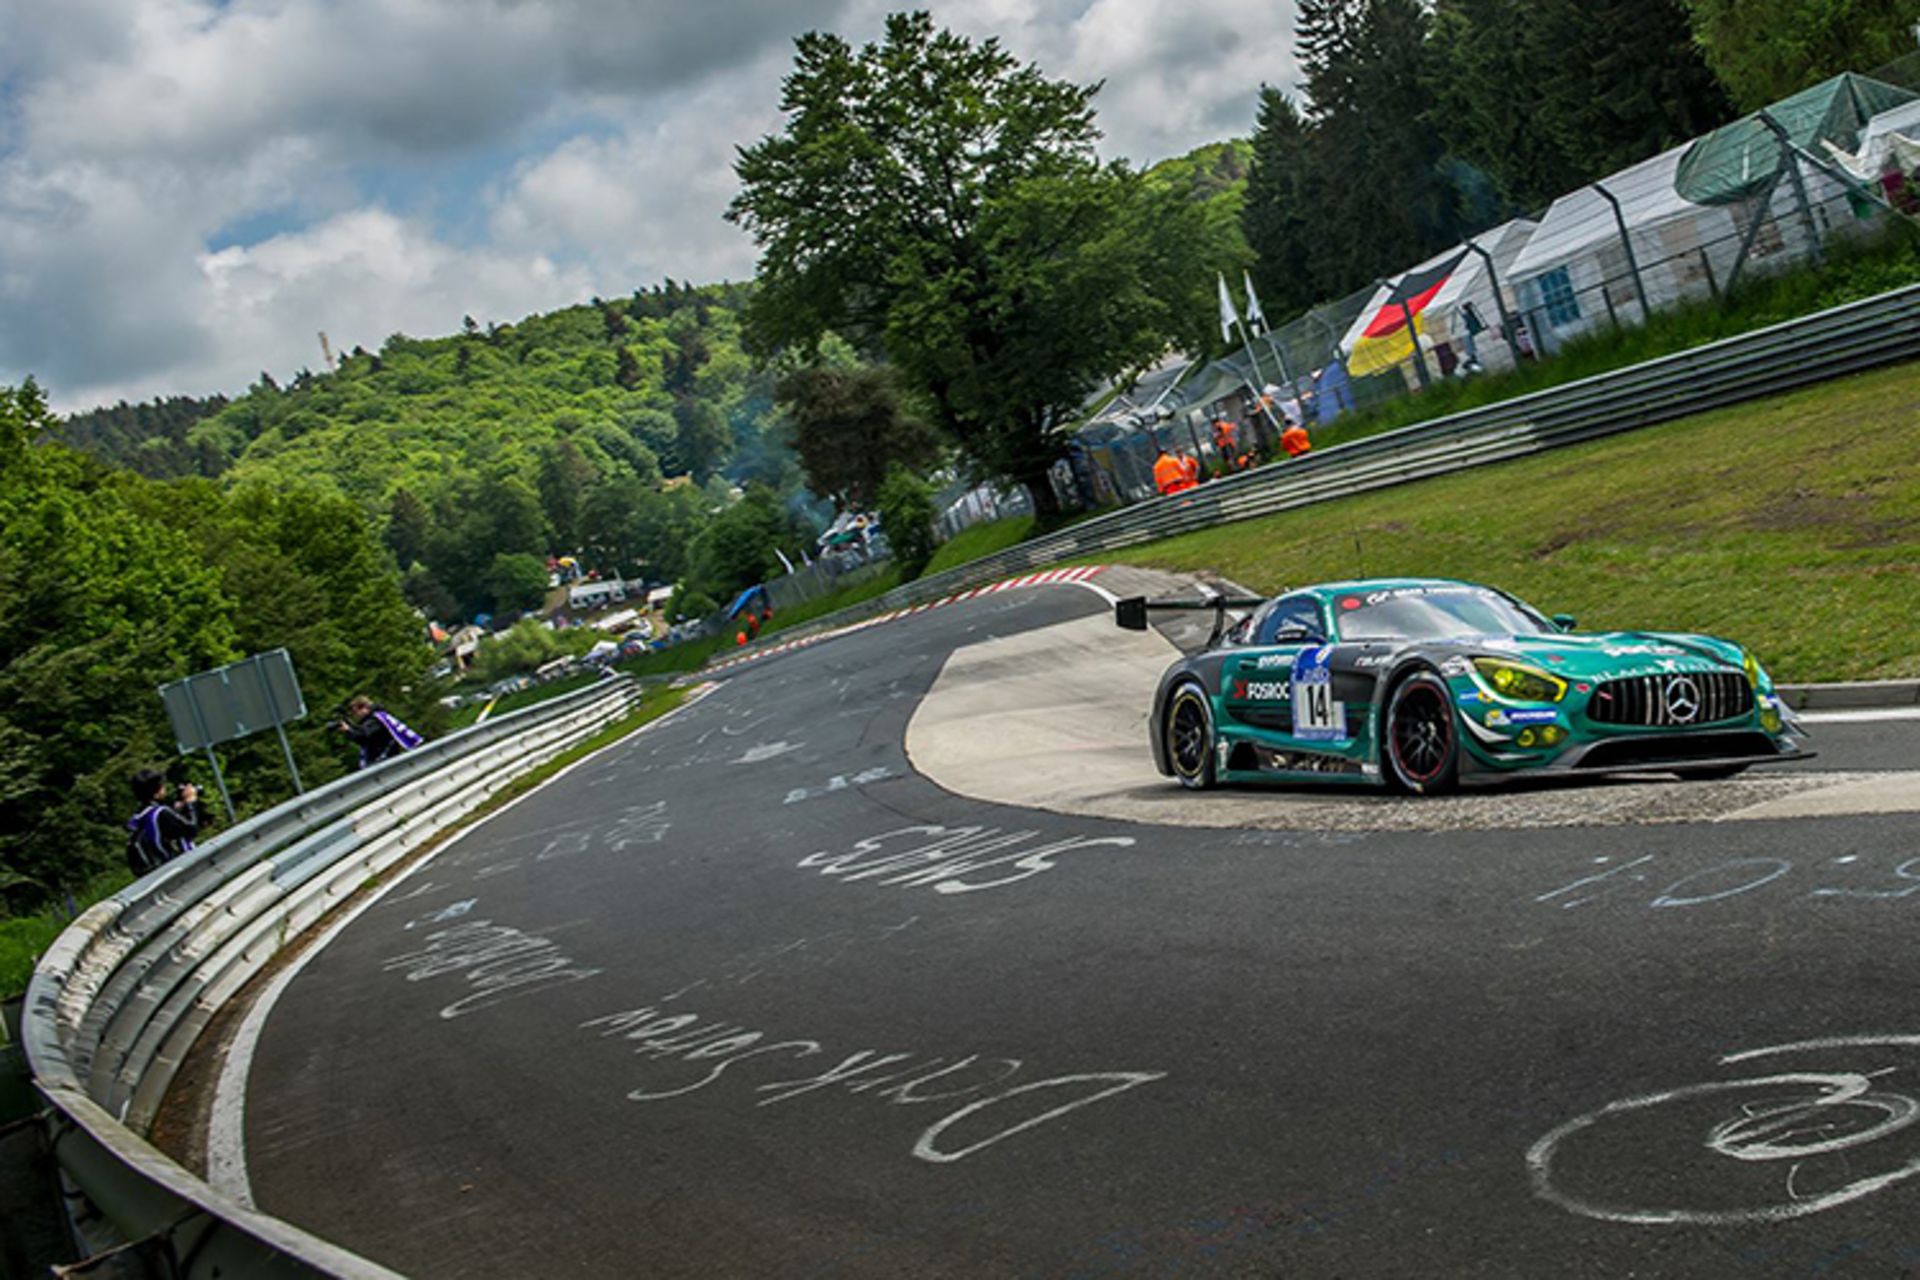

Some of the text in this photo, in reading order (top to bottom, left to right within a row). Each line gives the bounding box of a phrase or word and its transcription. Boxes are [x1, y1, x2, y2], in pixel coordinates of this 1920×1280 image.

[1247, 681, 1290, 700] FOSROC
[1307, 684, 1328, 727] 14
[755, 1050, 1169, 1163] Dark
